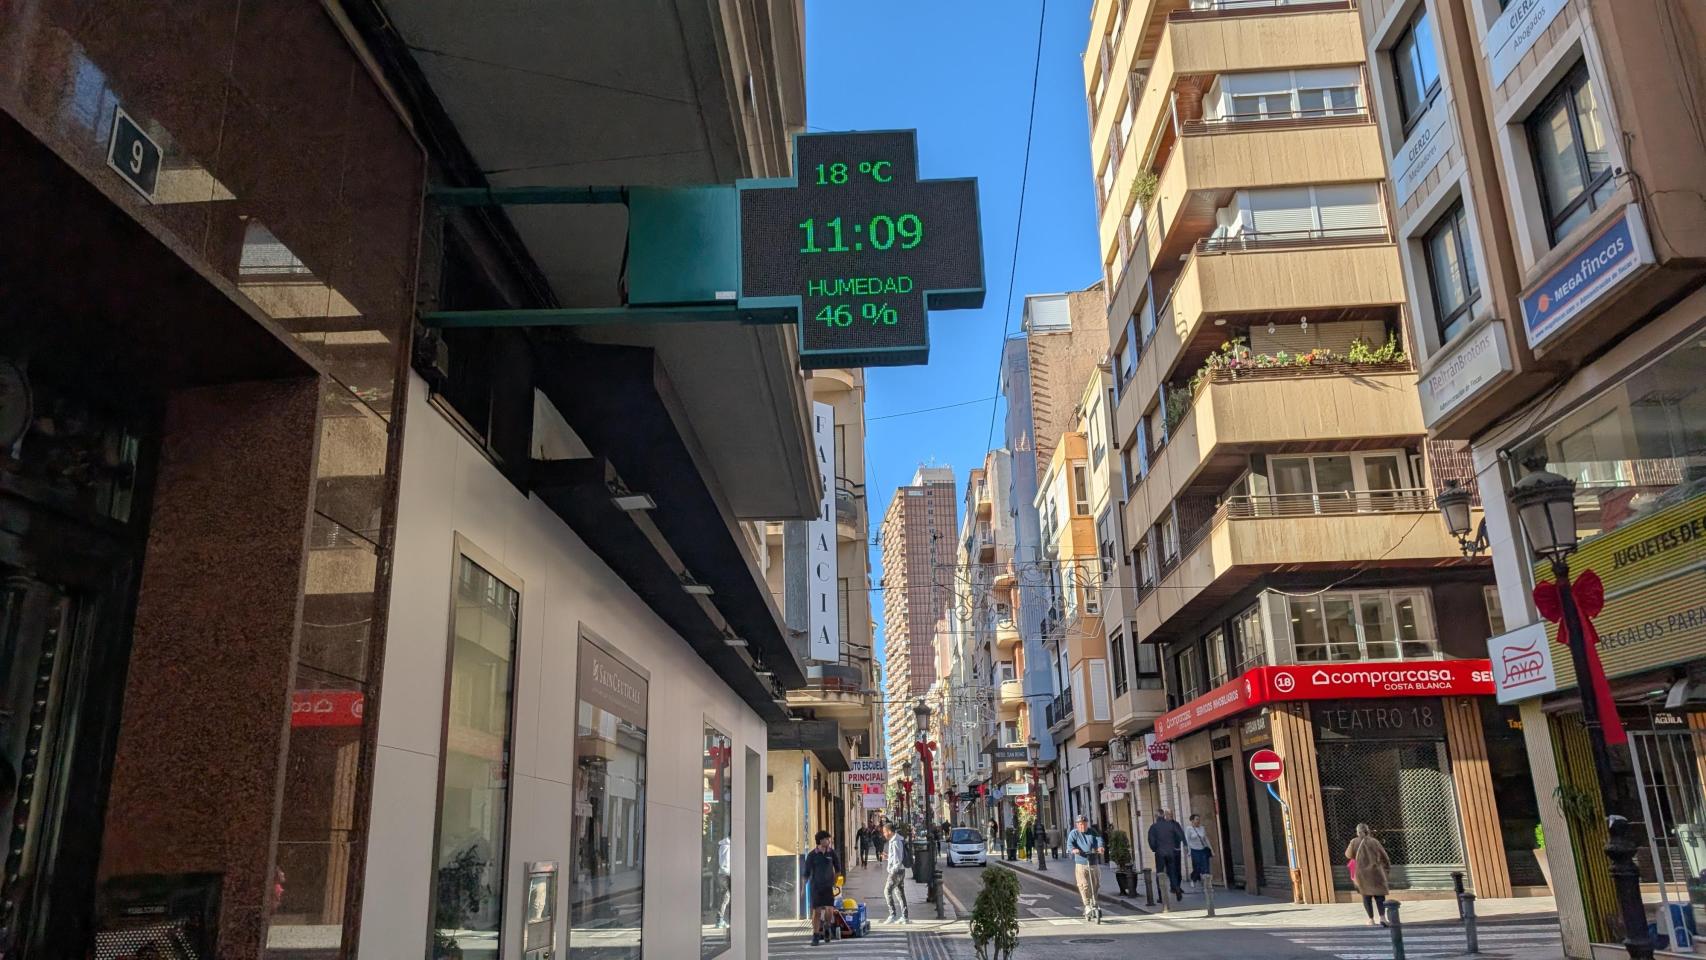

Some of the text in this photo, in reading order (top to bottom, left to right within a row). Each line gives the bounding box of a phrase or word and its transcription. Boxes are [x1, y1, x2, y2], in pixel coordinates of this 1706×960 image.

[1514, 7, 1546, 50] Abogados
[130, 140, 143, 174] 9
[1408, 129, 1430, 161] CIERZO
[815, 162, 848, 185] 18
[799, 214, 923, 253] 11:09
[1554, 237, 1624, 302] MEGAfincas
[808, 276, 913, 296] HUMEDAD
[815, 302, 898, 327] 46 %
[1613, 528, 1678, 569] JUGUETES
[1679, 519, 1700, 544] DE
[1600, 605, 1706, 651] REGALOS PARA
[1276, 677, 1292, 688] 18
[1384, 682, 1453, 691] COSTA BLANCA
[1322, 707, 1434, 730] TEATRO 18
[848, 773, 885, 782] PRINCIPAL
